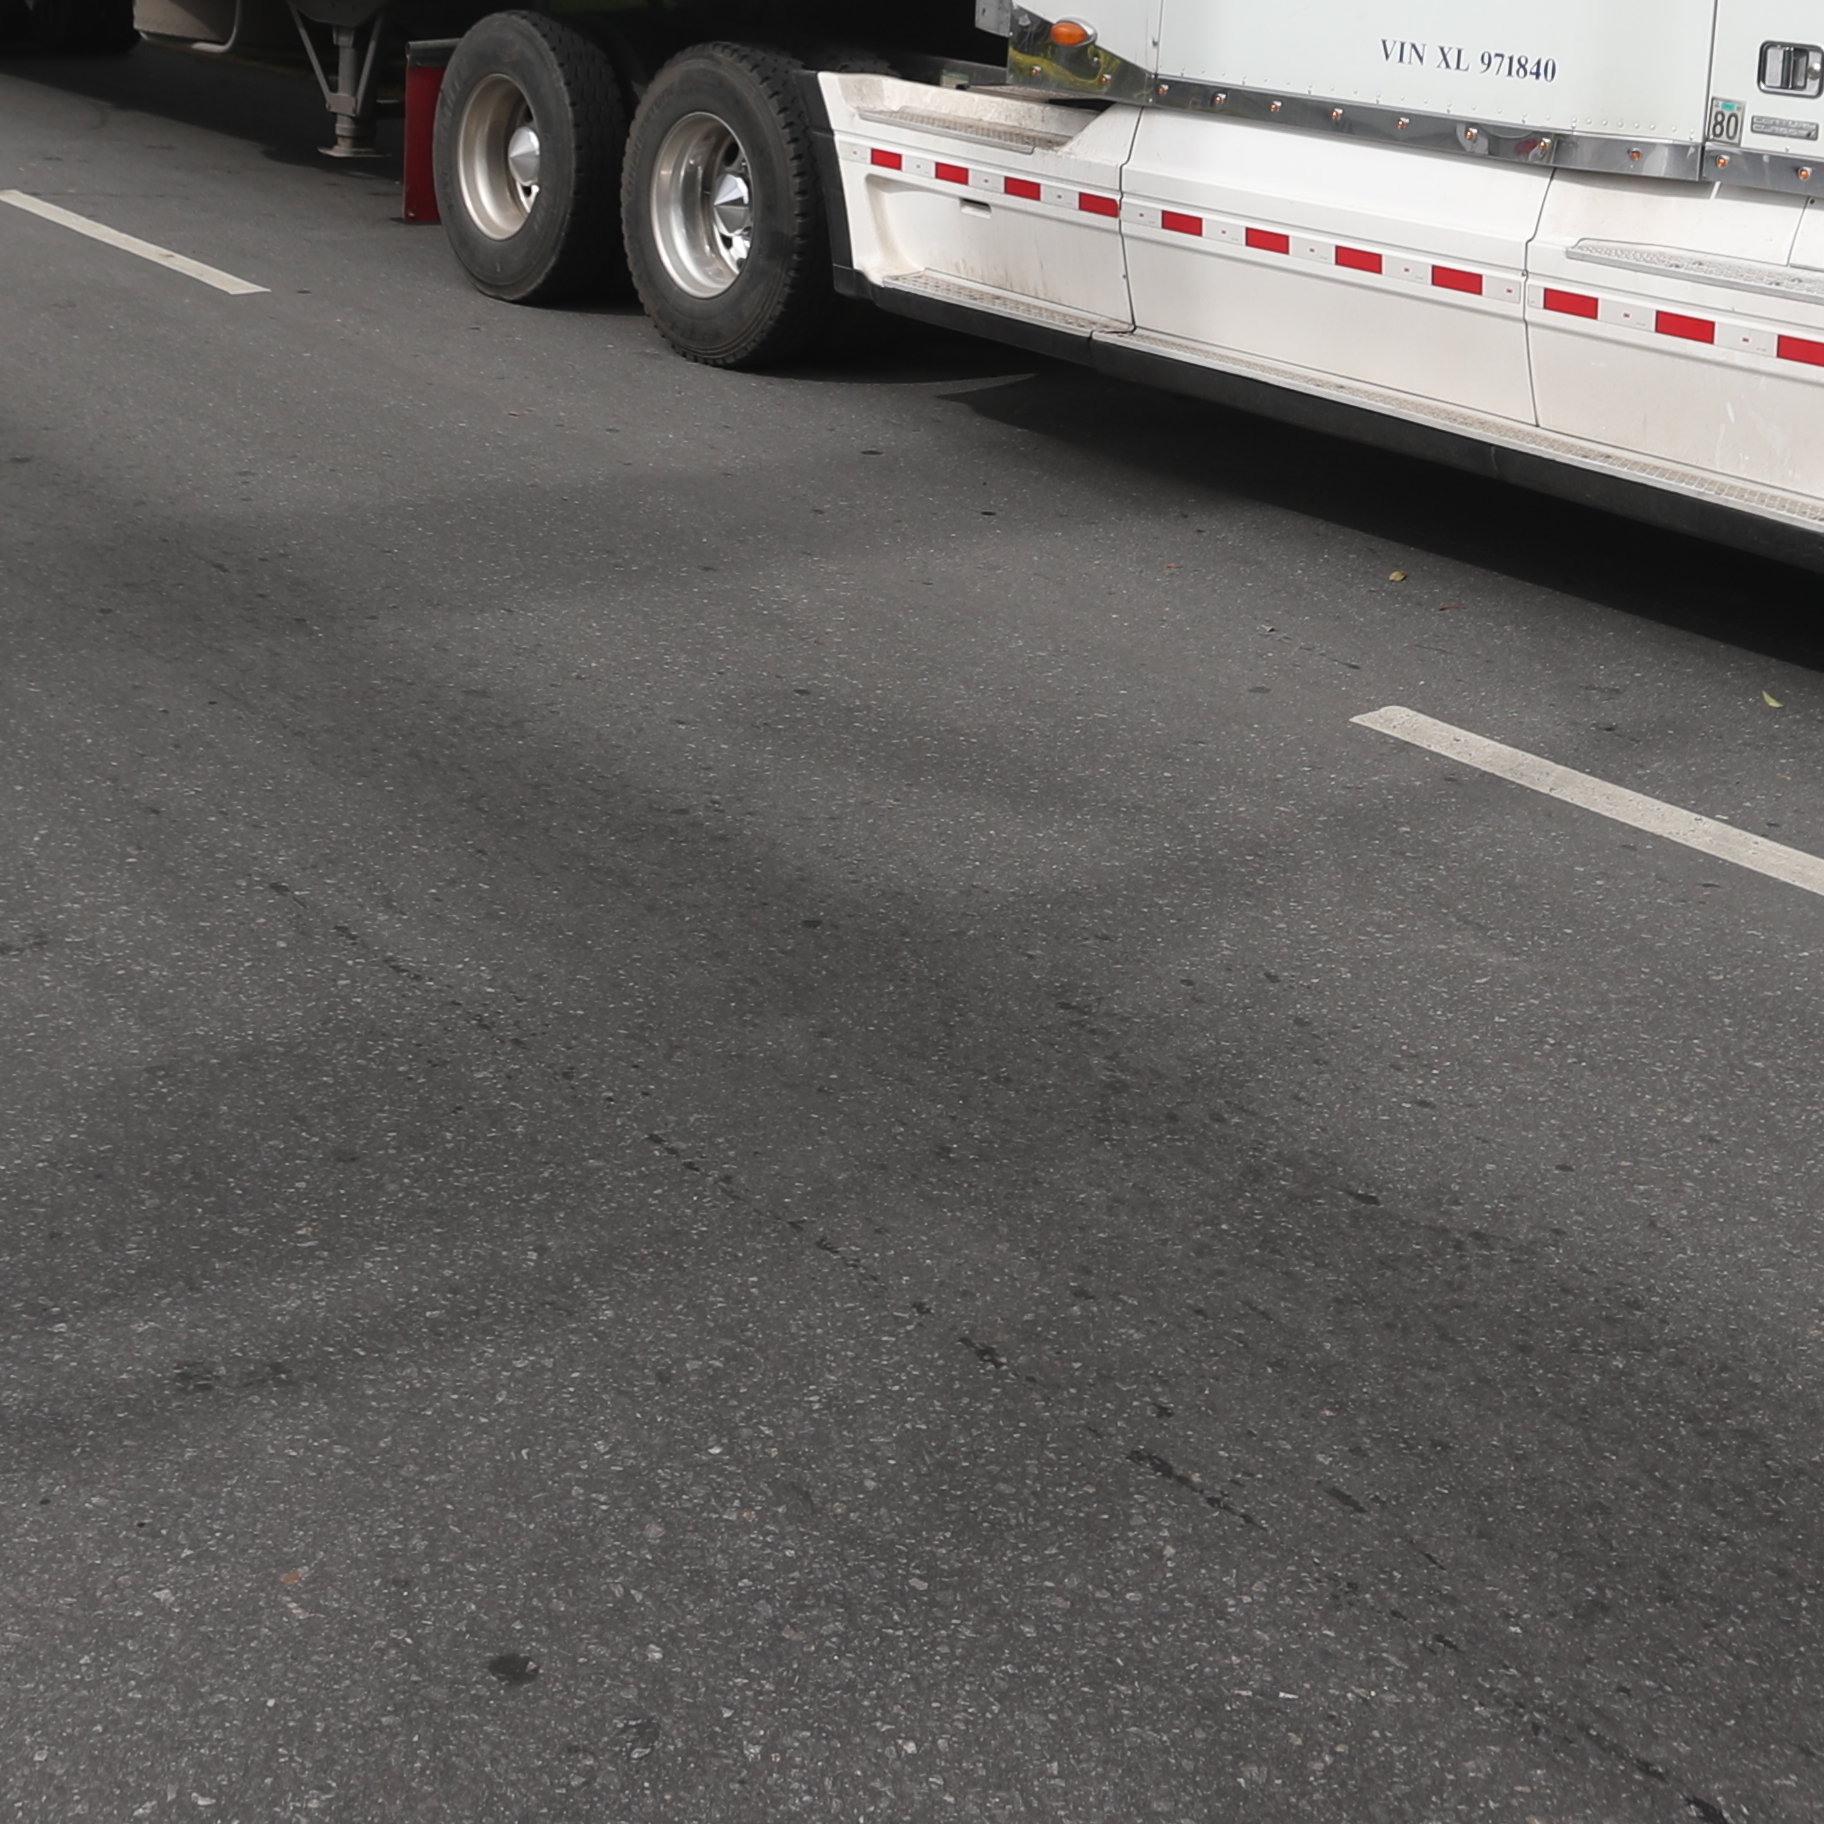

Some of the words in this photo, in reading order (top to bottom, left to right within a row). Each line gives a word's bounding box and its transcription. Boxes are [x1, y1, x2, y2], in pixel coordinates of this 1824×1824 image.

[1380, 38, 1427, 66] VIN
[1436, 45, 1471, 72] XL
[1479, 51, 1557, 83] 971840
[1712, 110, 1739, 141] 80
